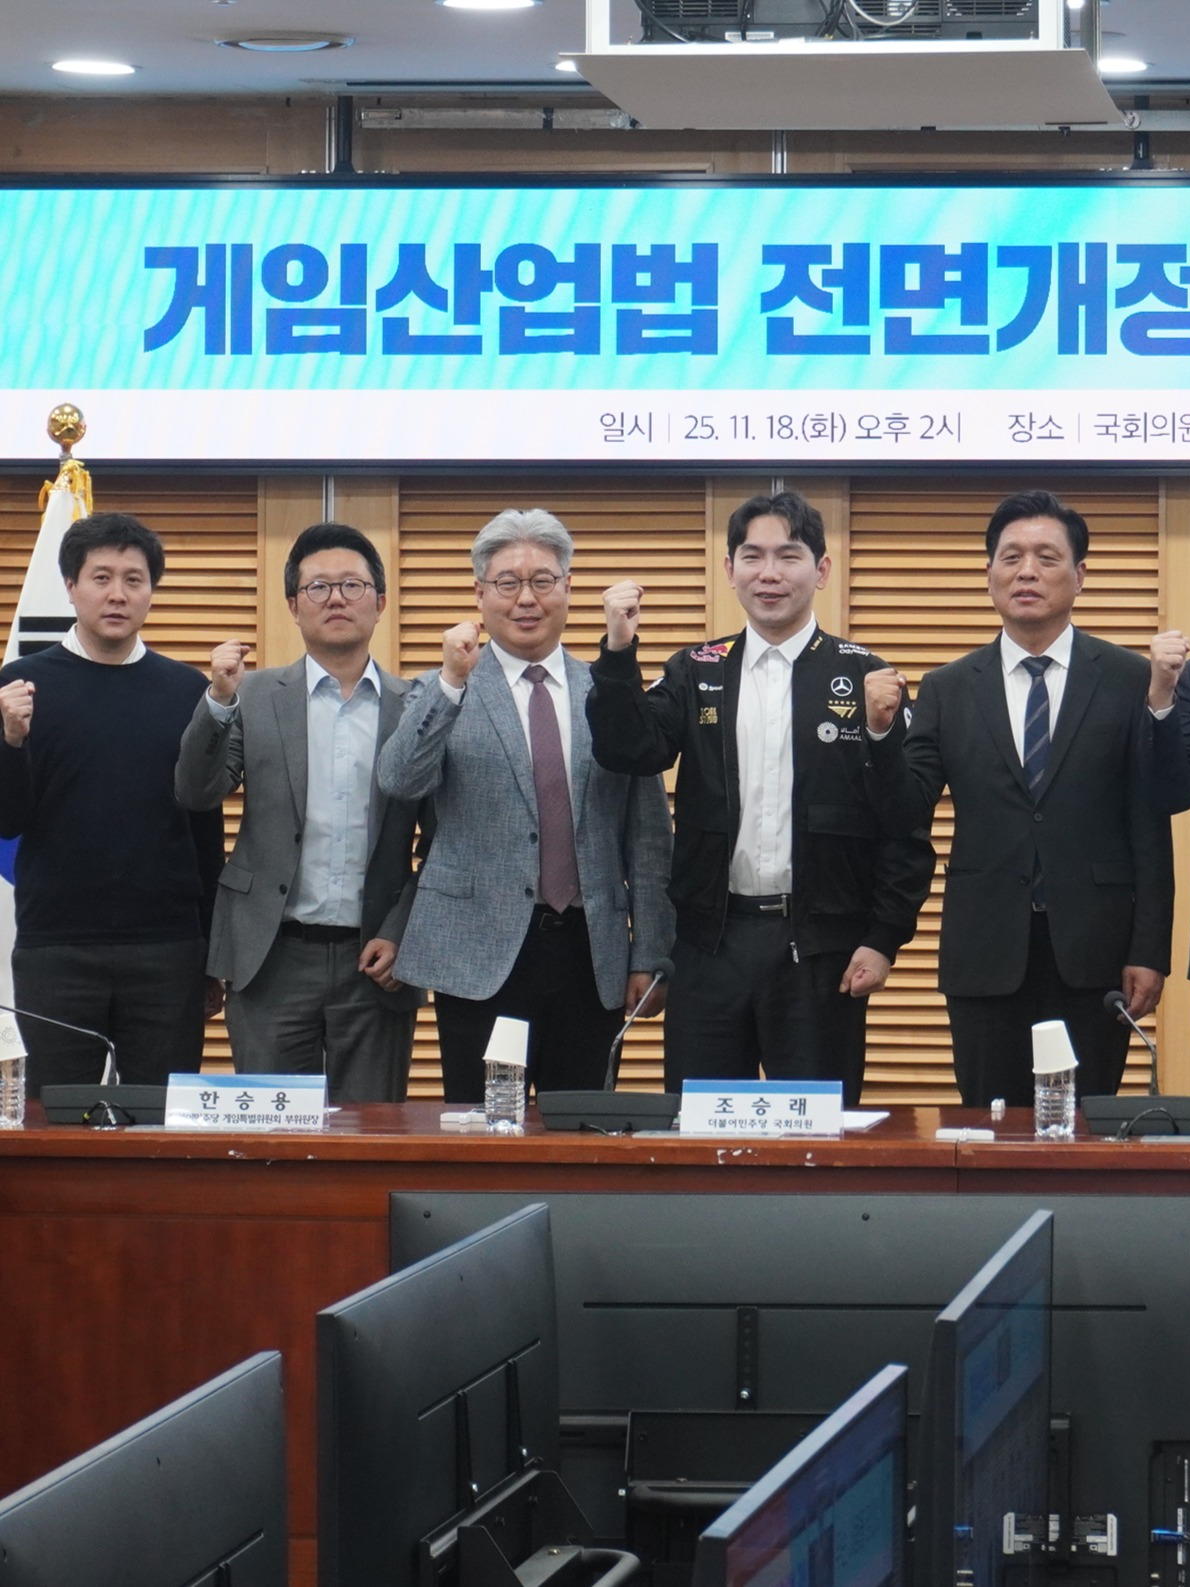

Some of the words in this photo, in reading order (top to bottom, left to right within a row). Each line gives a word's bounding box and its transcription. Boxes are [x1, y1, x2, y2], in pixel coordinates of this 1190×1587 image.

[143, 242, 719, 356] 게임산업법
[599, 411, 653, 443] 일시
[855, 412, 911, 444] 오후
[919, 411, 962, 443] 2시
[1008, 411, 1065, 444] 장소
[708, 1118, 768, 1130] 더불어민주당
[773, 1119, 814, 1130] 국회의원
